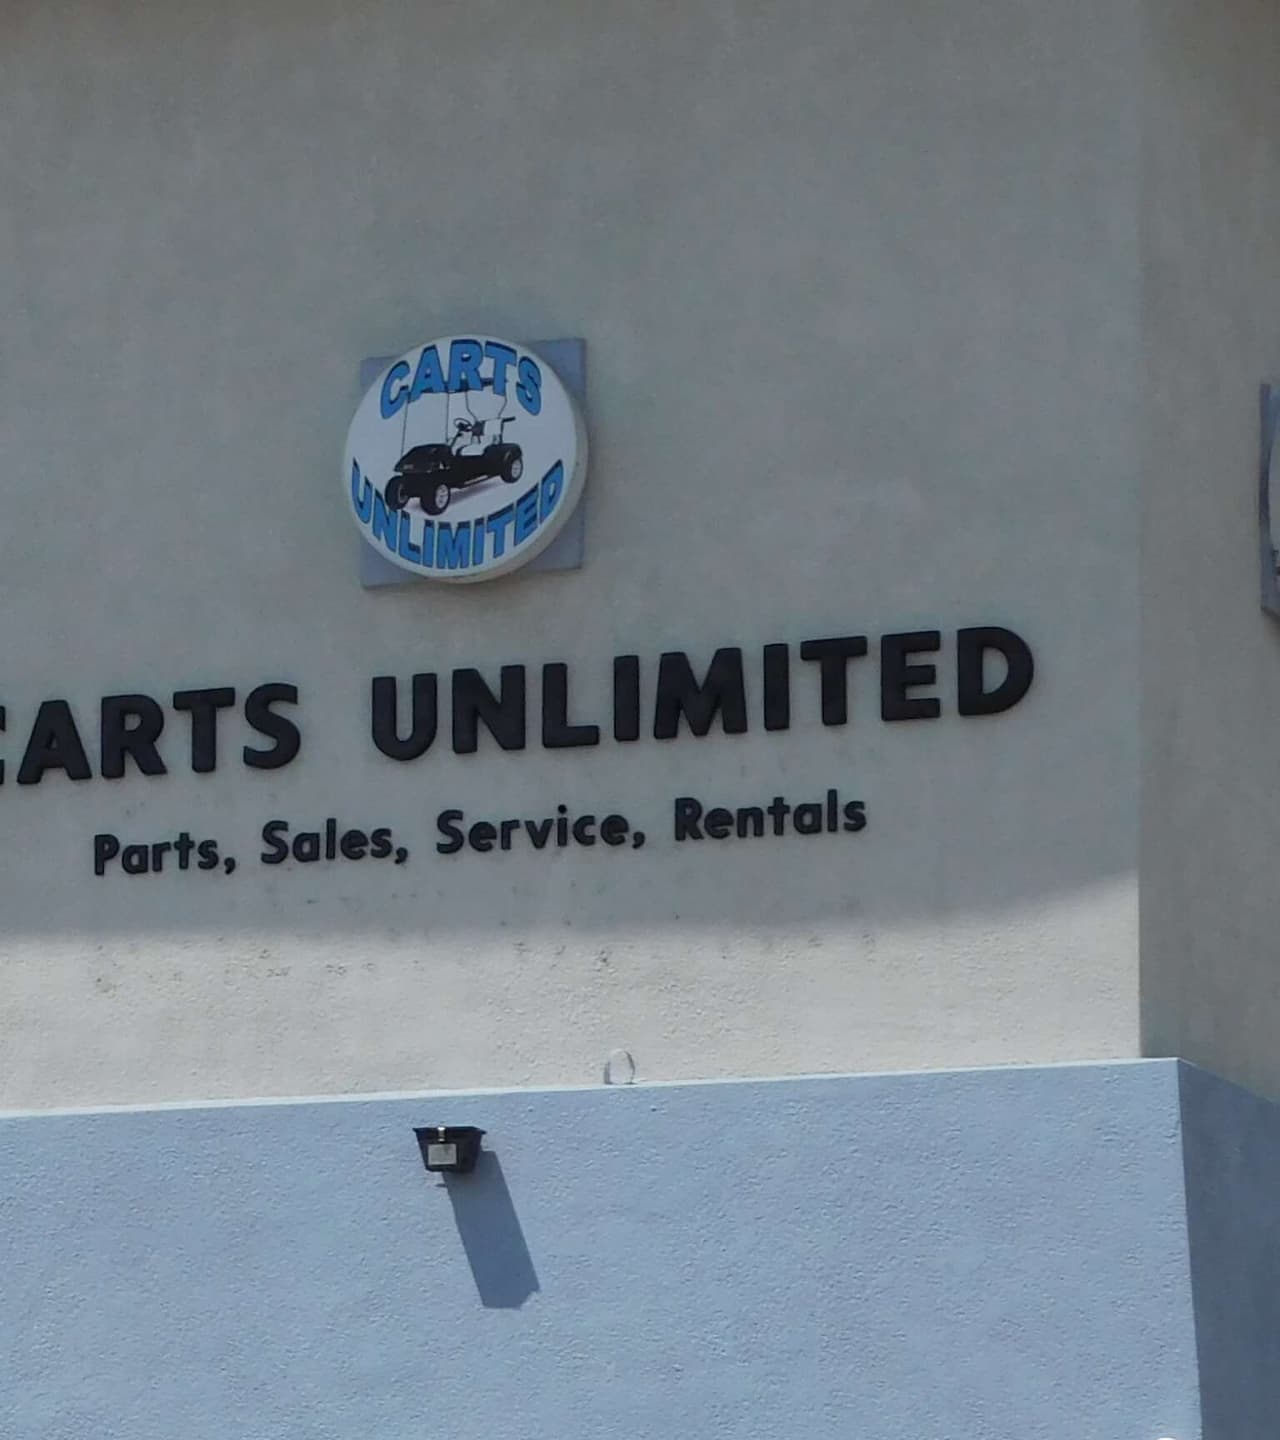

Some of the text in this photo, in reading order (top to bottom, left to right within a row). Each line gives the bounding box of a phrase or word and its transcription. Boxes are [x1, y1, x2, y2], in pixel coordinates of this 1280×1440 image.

[380, 339, 542, 419] CARTS
[351, 458, 565, 570] UNLIMITED
[369, 626, 1036, 762] UNLIMITED
[93, 788, 868, 877] Parts, Sales, Service, Rentals
